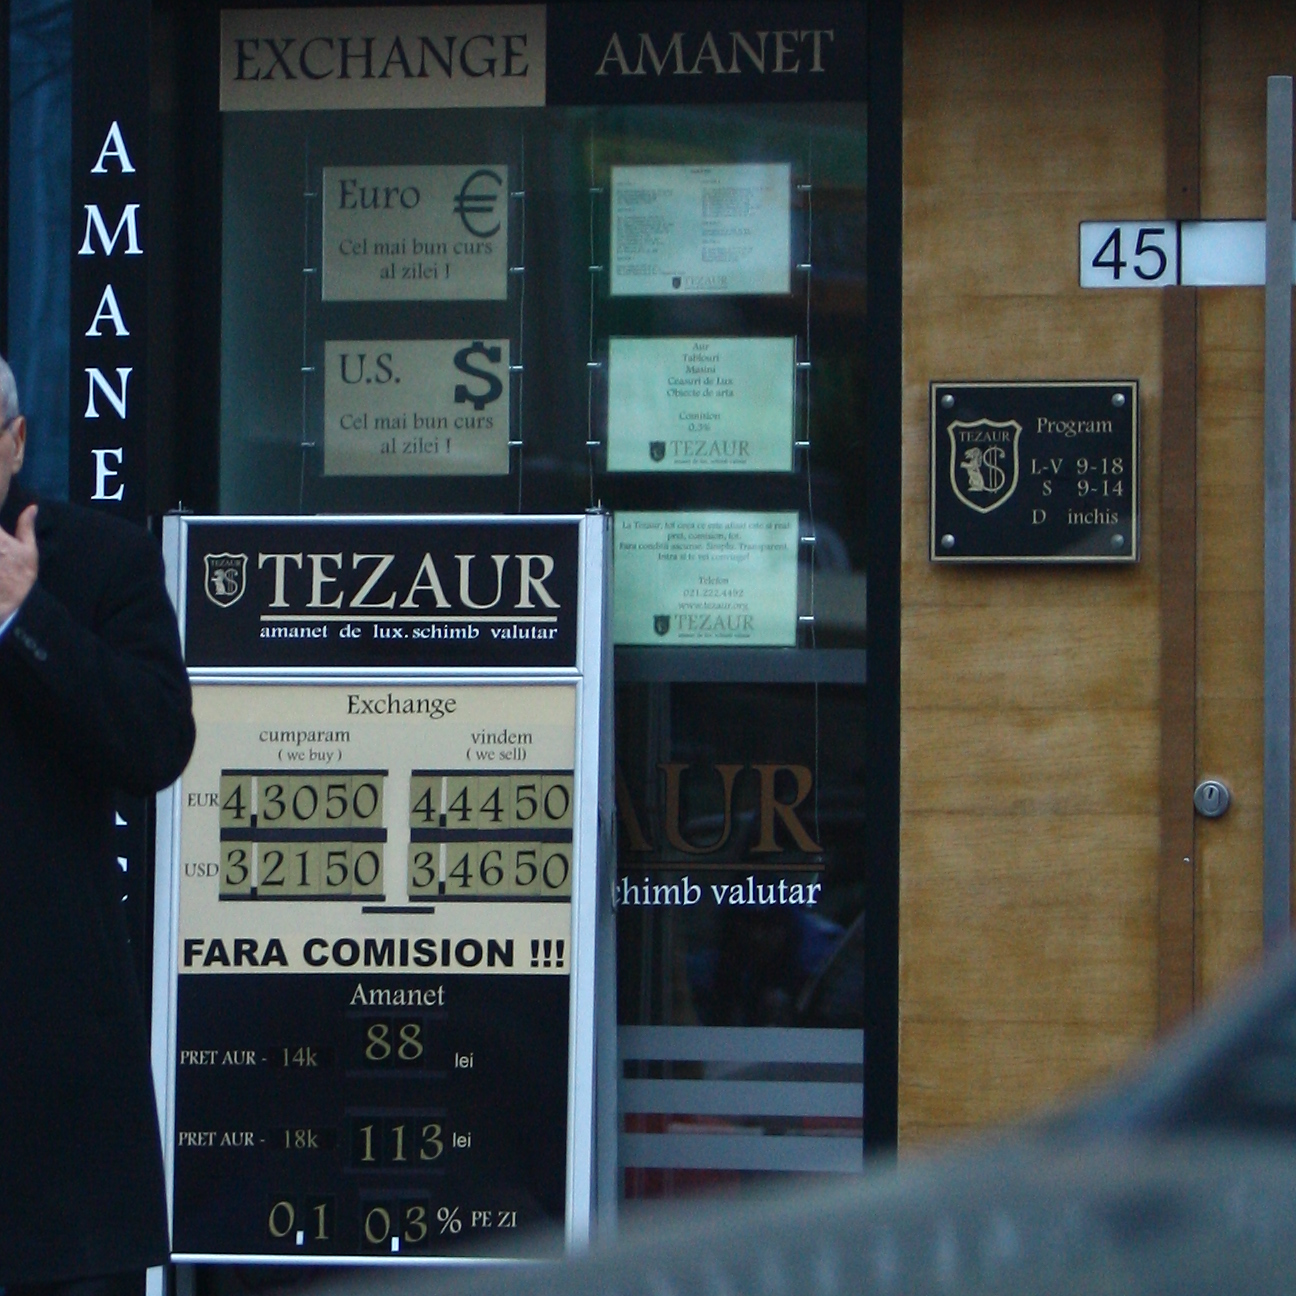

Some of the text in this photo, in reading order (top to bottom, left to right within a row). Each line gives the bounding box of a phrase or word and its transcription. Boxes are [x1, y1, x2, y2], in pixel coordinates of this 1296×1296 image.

[232, 29, 835, 82] EXCHANGE AMANET
[337, 178, 422, 210] Euro
[338, 237, 493, 257] Cel mai bun curs
[1092, 227, 1167, 280] 45
[379, 263, 397, 281] al
[401, 262, 442, 280] zilei
[339, 354, 402, 386] U.S.
[339, 411, 494, 431] Cel mai bun curs
[1036, 417, 1113, 437] Program
[379, 437, 398, 454] al
[401, 436, 442, 454] zilei
[959, 431, 1010, 443] TEZAUR
[670, 440, 749, 456] TEZAUR
[1031, 458, 1124, 475] L-V 9-18
[1042, 480, 1124, 497] S 9-14
[1031, 508, 1119, 525] D inchis
[258, 552, 561, 610] TEZAUR
[259, 624, 328, 639] amanet
[339, 624, 362, 639] de
[490, 624, 558, 640] valutar
[674, 614, 755, 632] TEZAUR
[346, 694, 457, 719] Exchange
[258, 731, 351, 746] cumparam
[471, 729, 533, 747] vindem
[187, 793, 219, 808] EUR
[185, 862, 219, 878] USD
[711, 873, 822, 906] valutar
[183, 937, 566, 969] FARA COMISION !!!
[349, 982, 446, 1007] Amanet
[365, 1022, 424, 1063] 88
[180, 1050, 218, 1065] PRET
[221, 1050, 258, 1065] AUR
[281, 1044, 318, 1068] 14k
[455, 1052, 474, 1068] lei
[178, 1132, 217, 1147] PRET
[220, 1132, 256, 1147] AUR
[282, 1126, 319, 1149] 18k
[452, 1131, 472, 1148] lei
[359, 1122, 445, 1163] 113
[471, 1211, 493, 1227] PE
[497, 1209, 518, 1226] ZI
